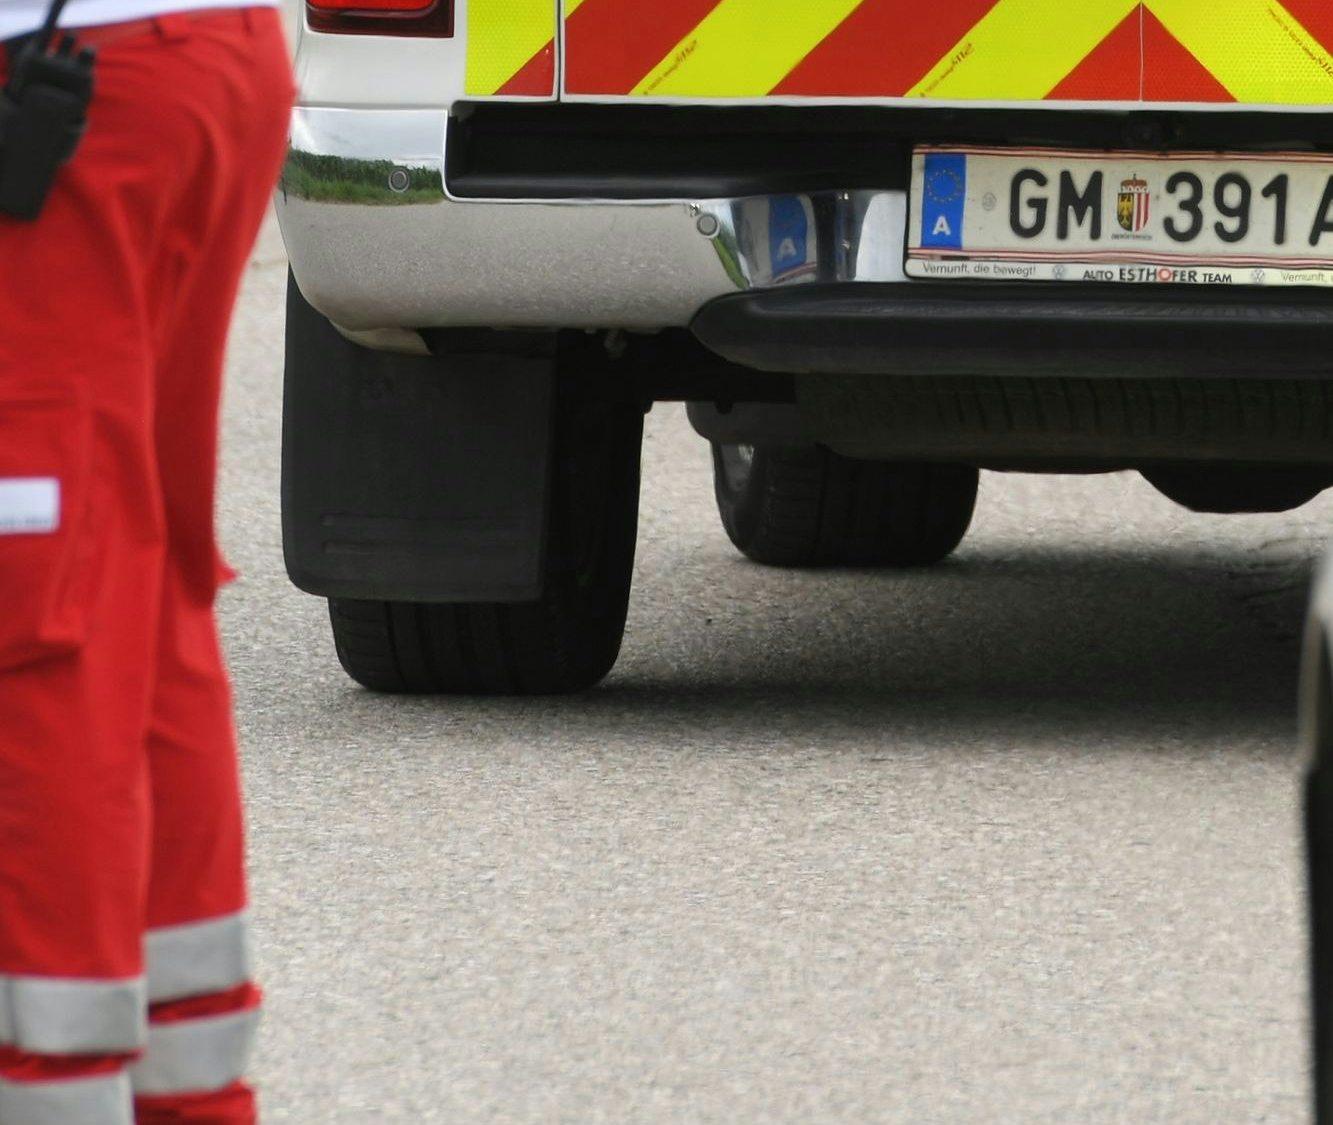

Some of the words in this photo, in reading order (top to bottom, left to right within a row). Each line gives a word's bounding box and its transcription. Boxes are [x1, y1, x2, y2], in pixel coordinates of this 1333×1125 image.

[1009, 167, 1104, 241] GM
[974, 263, 989, 274] die
[1083, 270, 1114, 281] AUTO
[1119, 267, 1198, 283] ESTHOFER
[1202, 273, 1232, 283] TEAM
